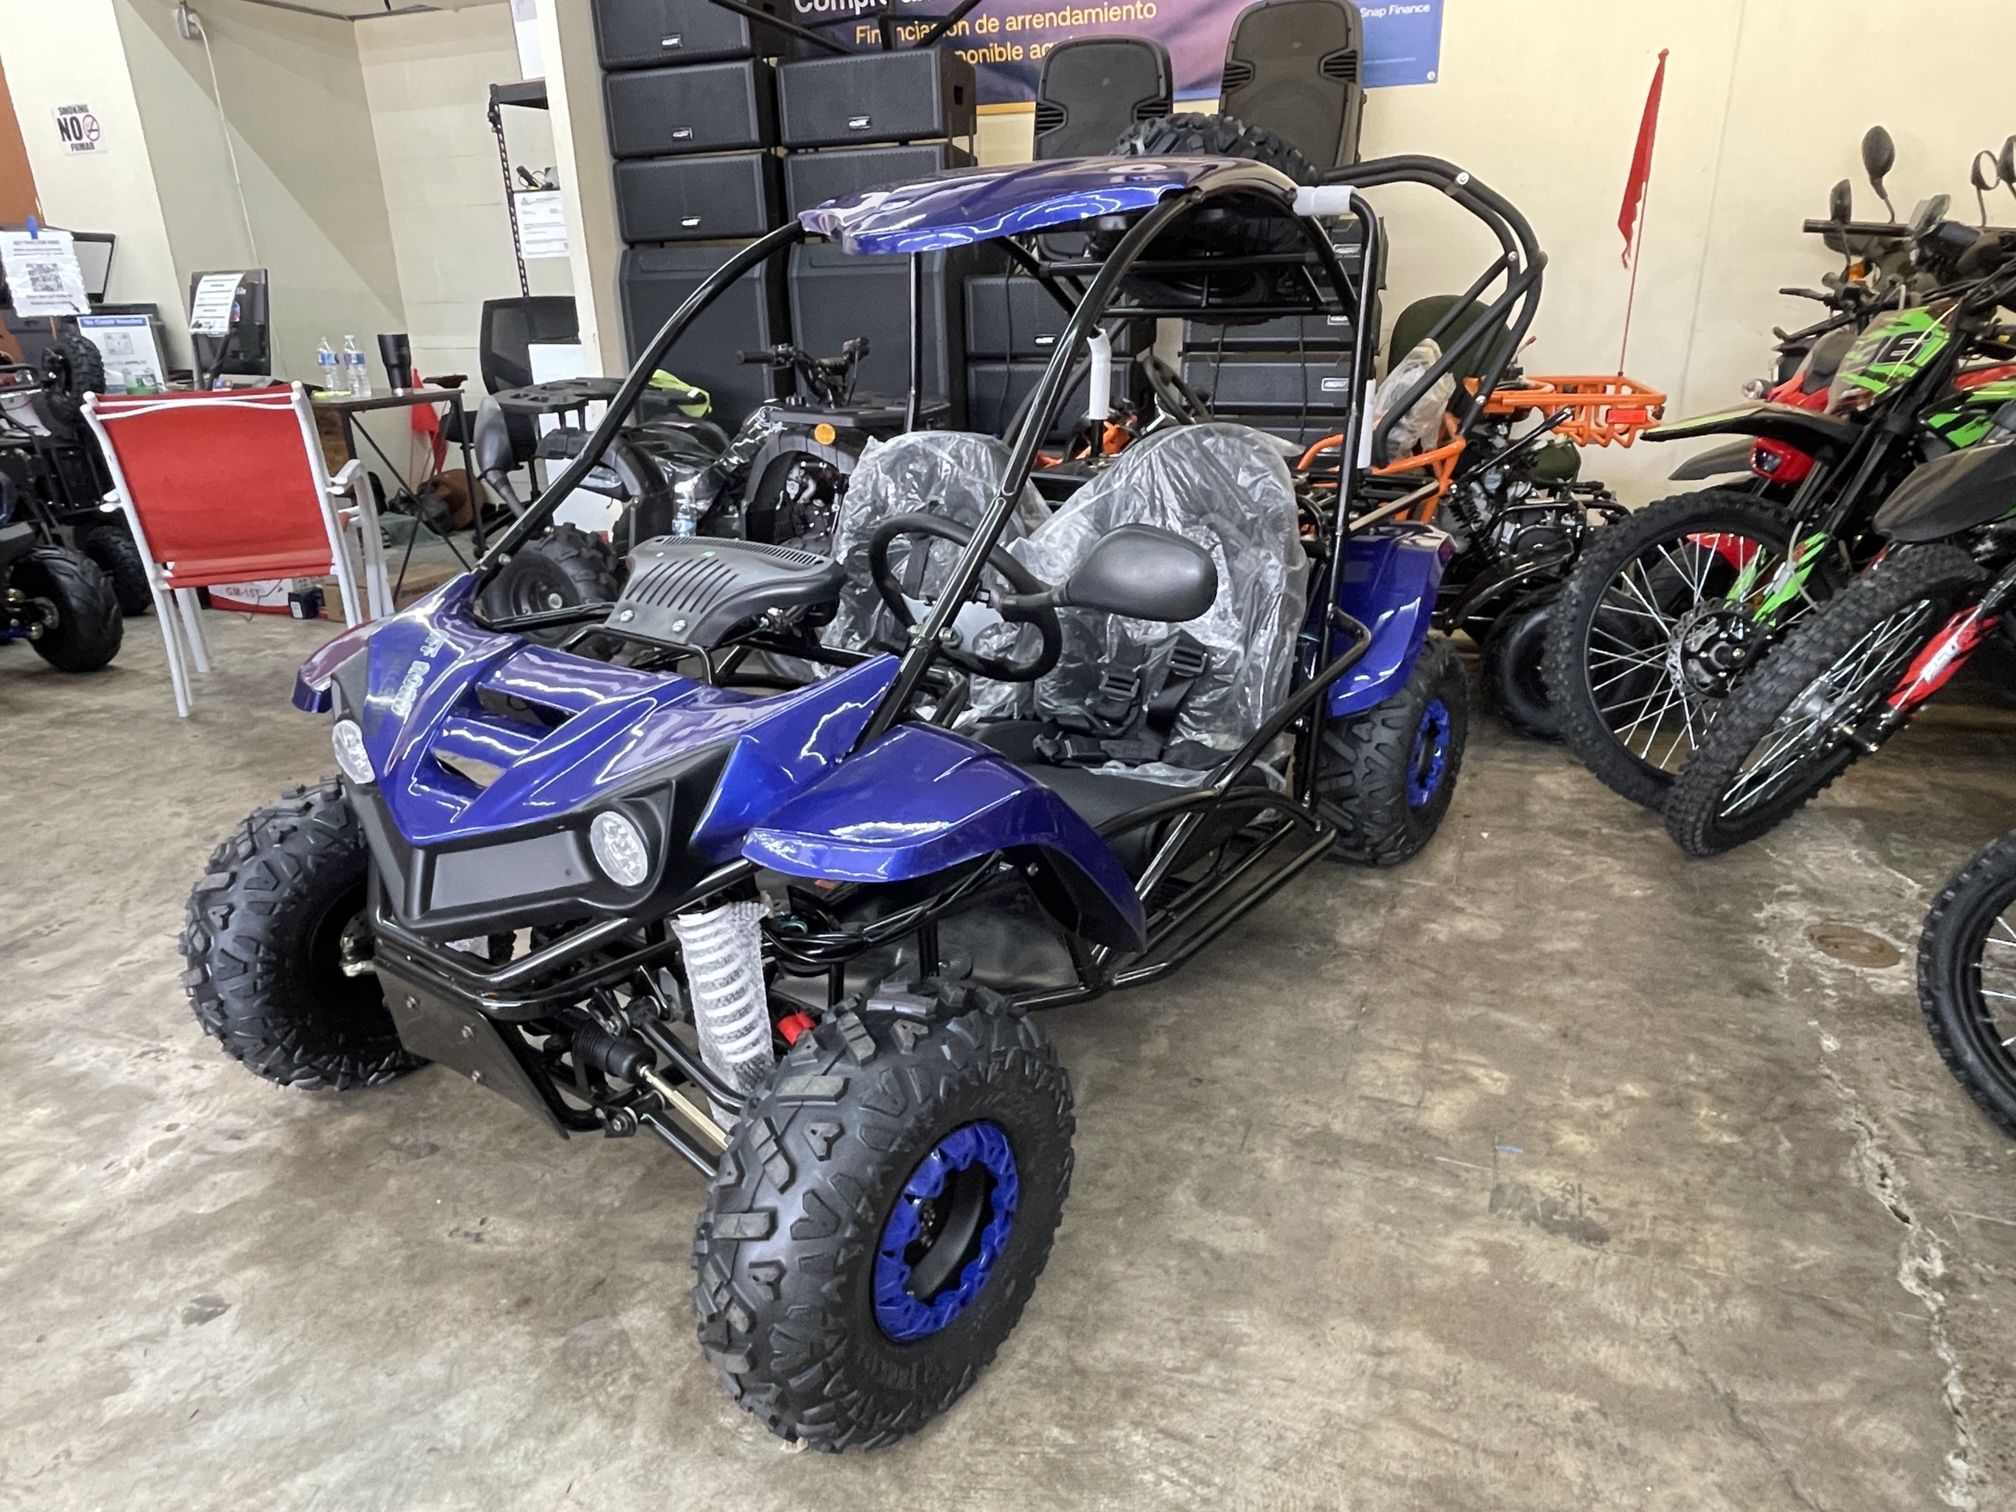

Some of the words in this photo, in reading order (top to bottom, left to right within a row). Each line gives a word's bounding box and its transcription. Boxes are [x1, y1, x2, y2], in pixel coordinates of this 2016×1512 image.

[794, 0, 888, 15] Compr
[975, 14, 1000, 34] de
[1005, 1, 1157, 31] arrendamiento
[1360, 7, 1387, 18] Snap
[1389, 4, 1431, 15] Finance
[56, 116, 83, 142] NO
